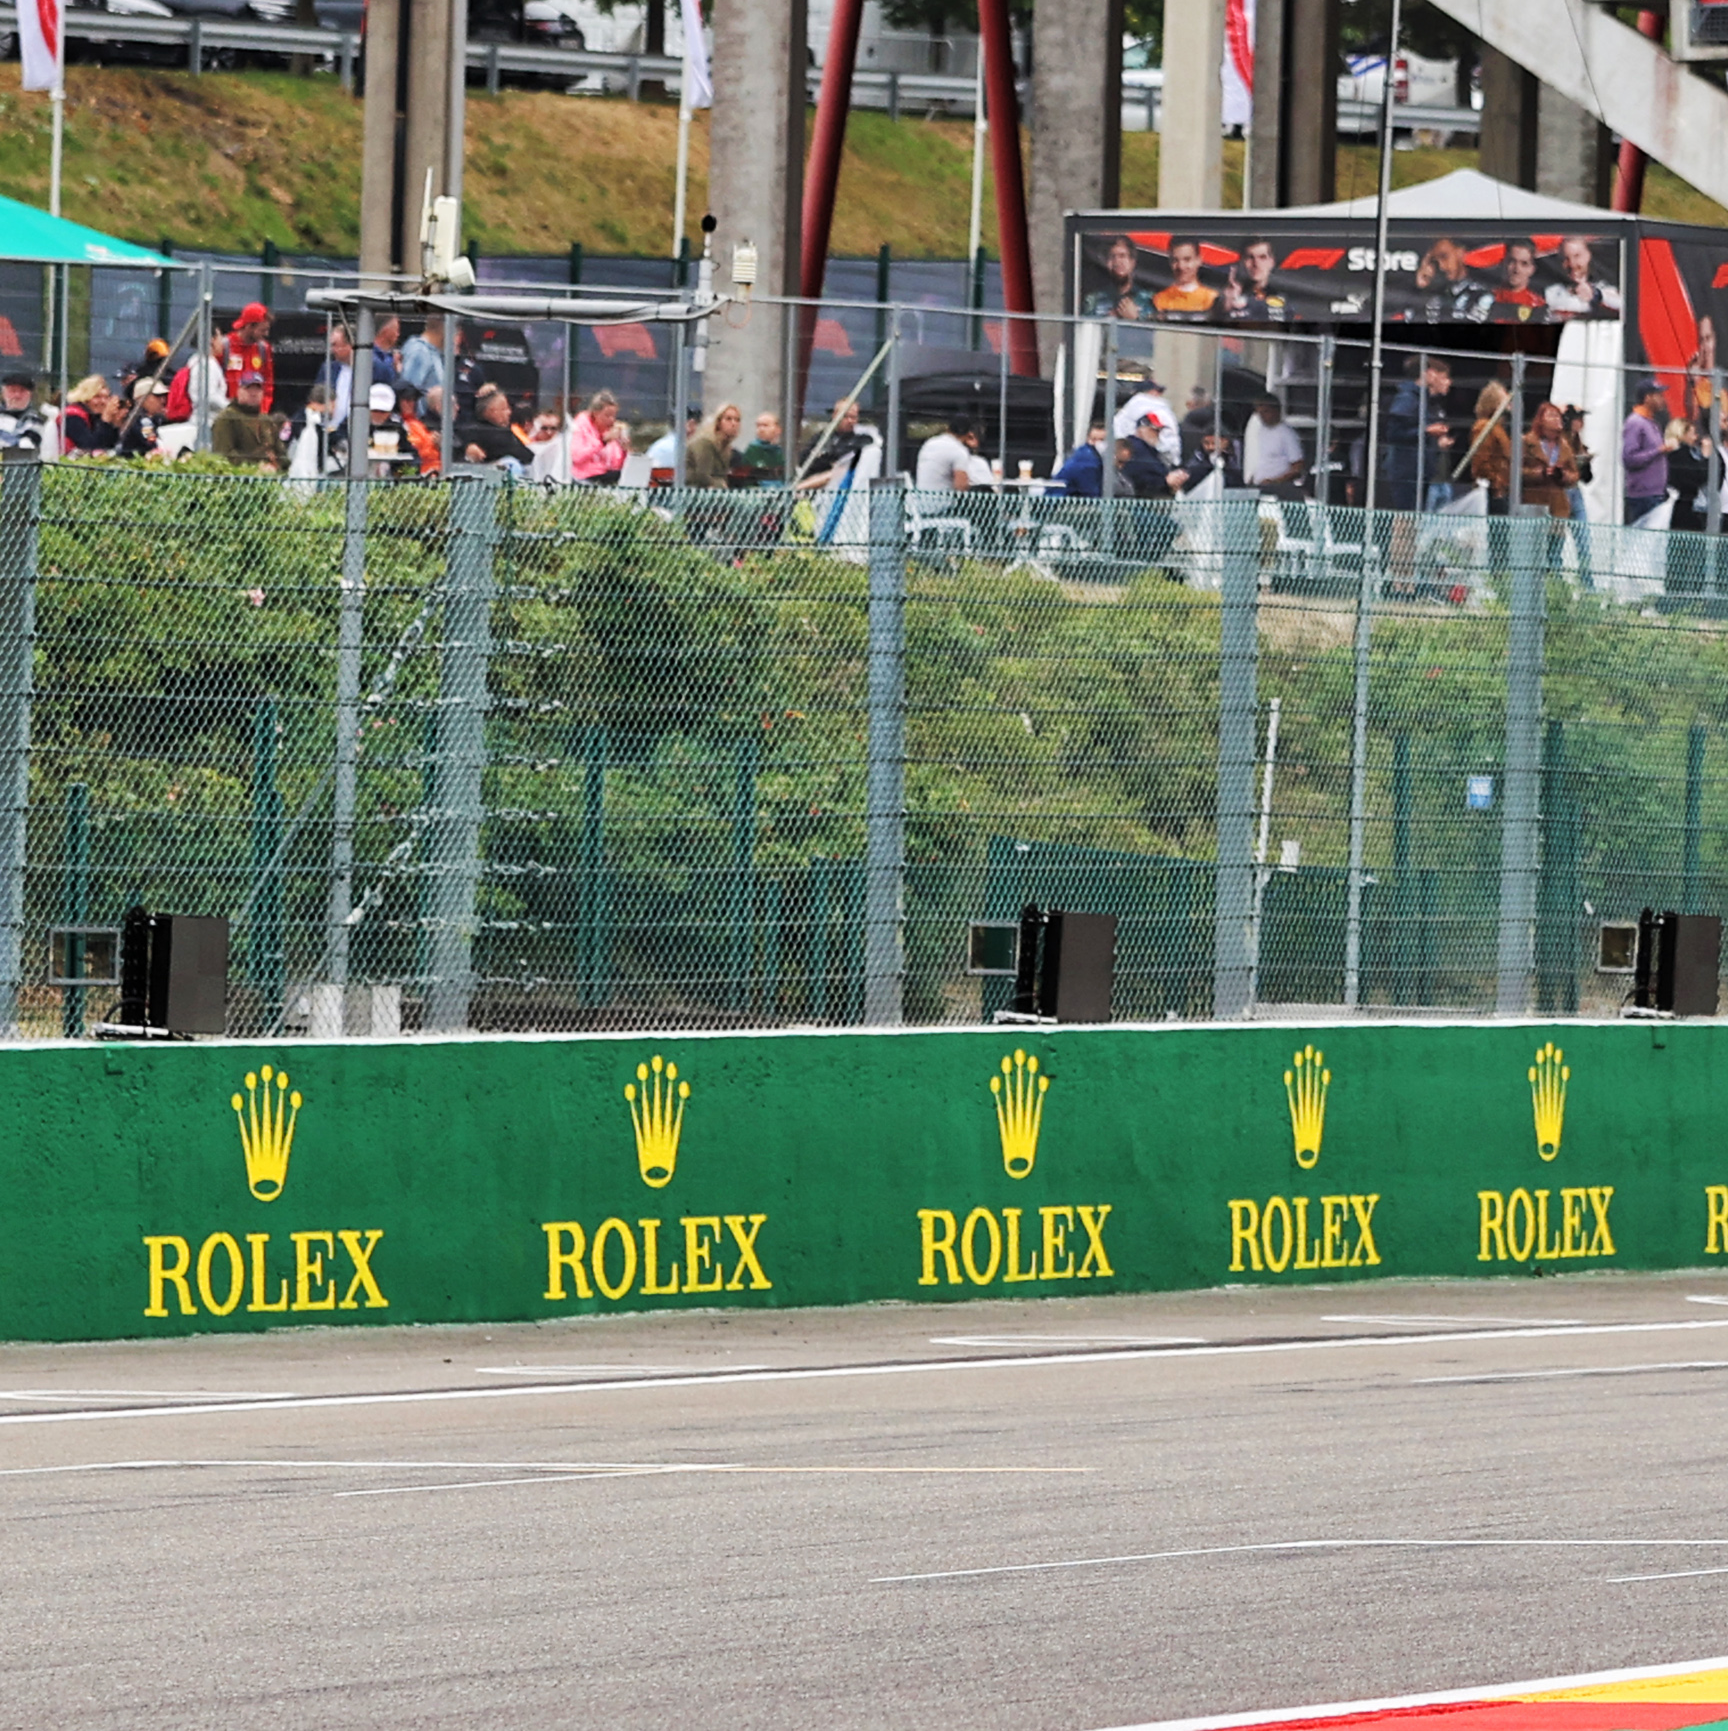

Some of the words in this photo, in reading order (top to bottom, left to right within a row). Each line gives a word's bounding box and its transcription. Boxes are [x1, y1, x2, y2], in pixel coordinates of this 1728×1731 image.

[542, 1214, 772, 1299] ROLEX
[917, 1205, 1114, 1285] ROLEX
[1228, 1194, 1381, 1272] ROLEX
[1478, 1186, 1616, 1262] ROLEX
[144, 1230, 388, 1317] ROLEX
